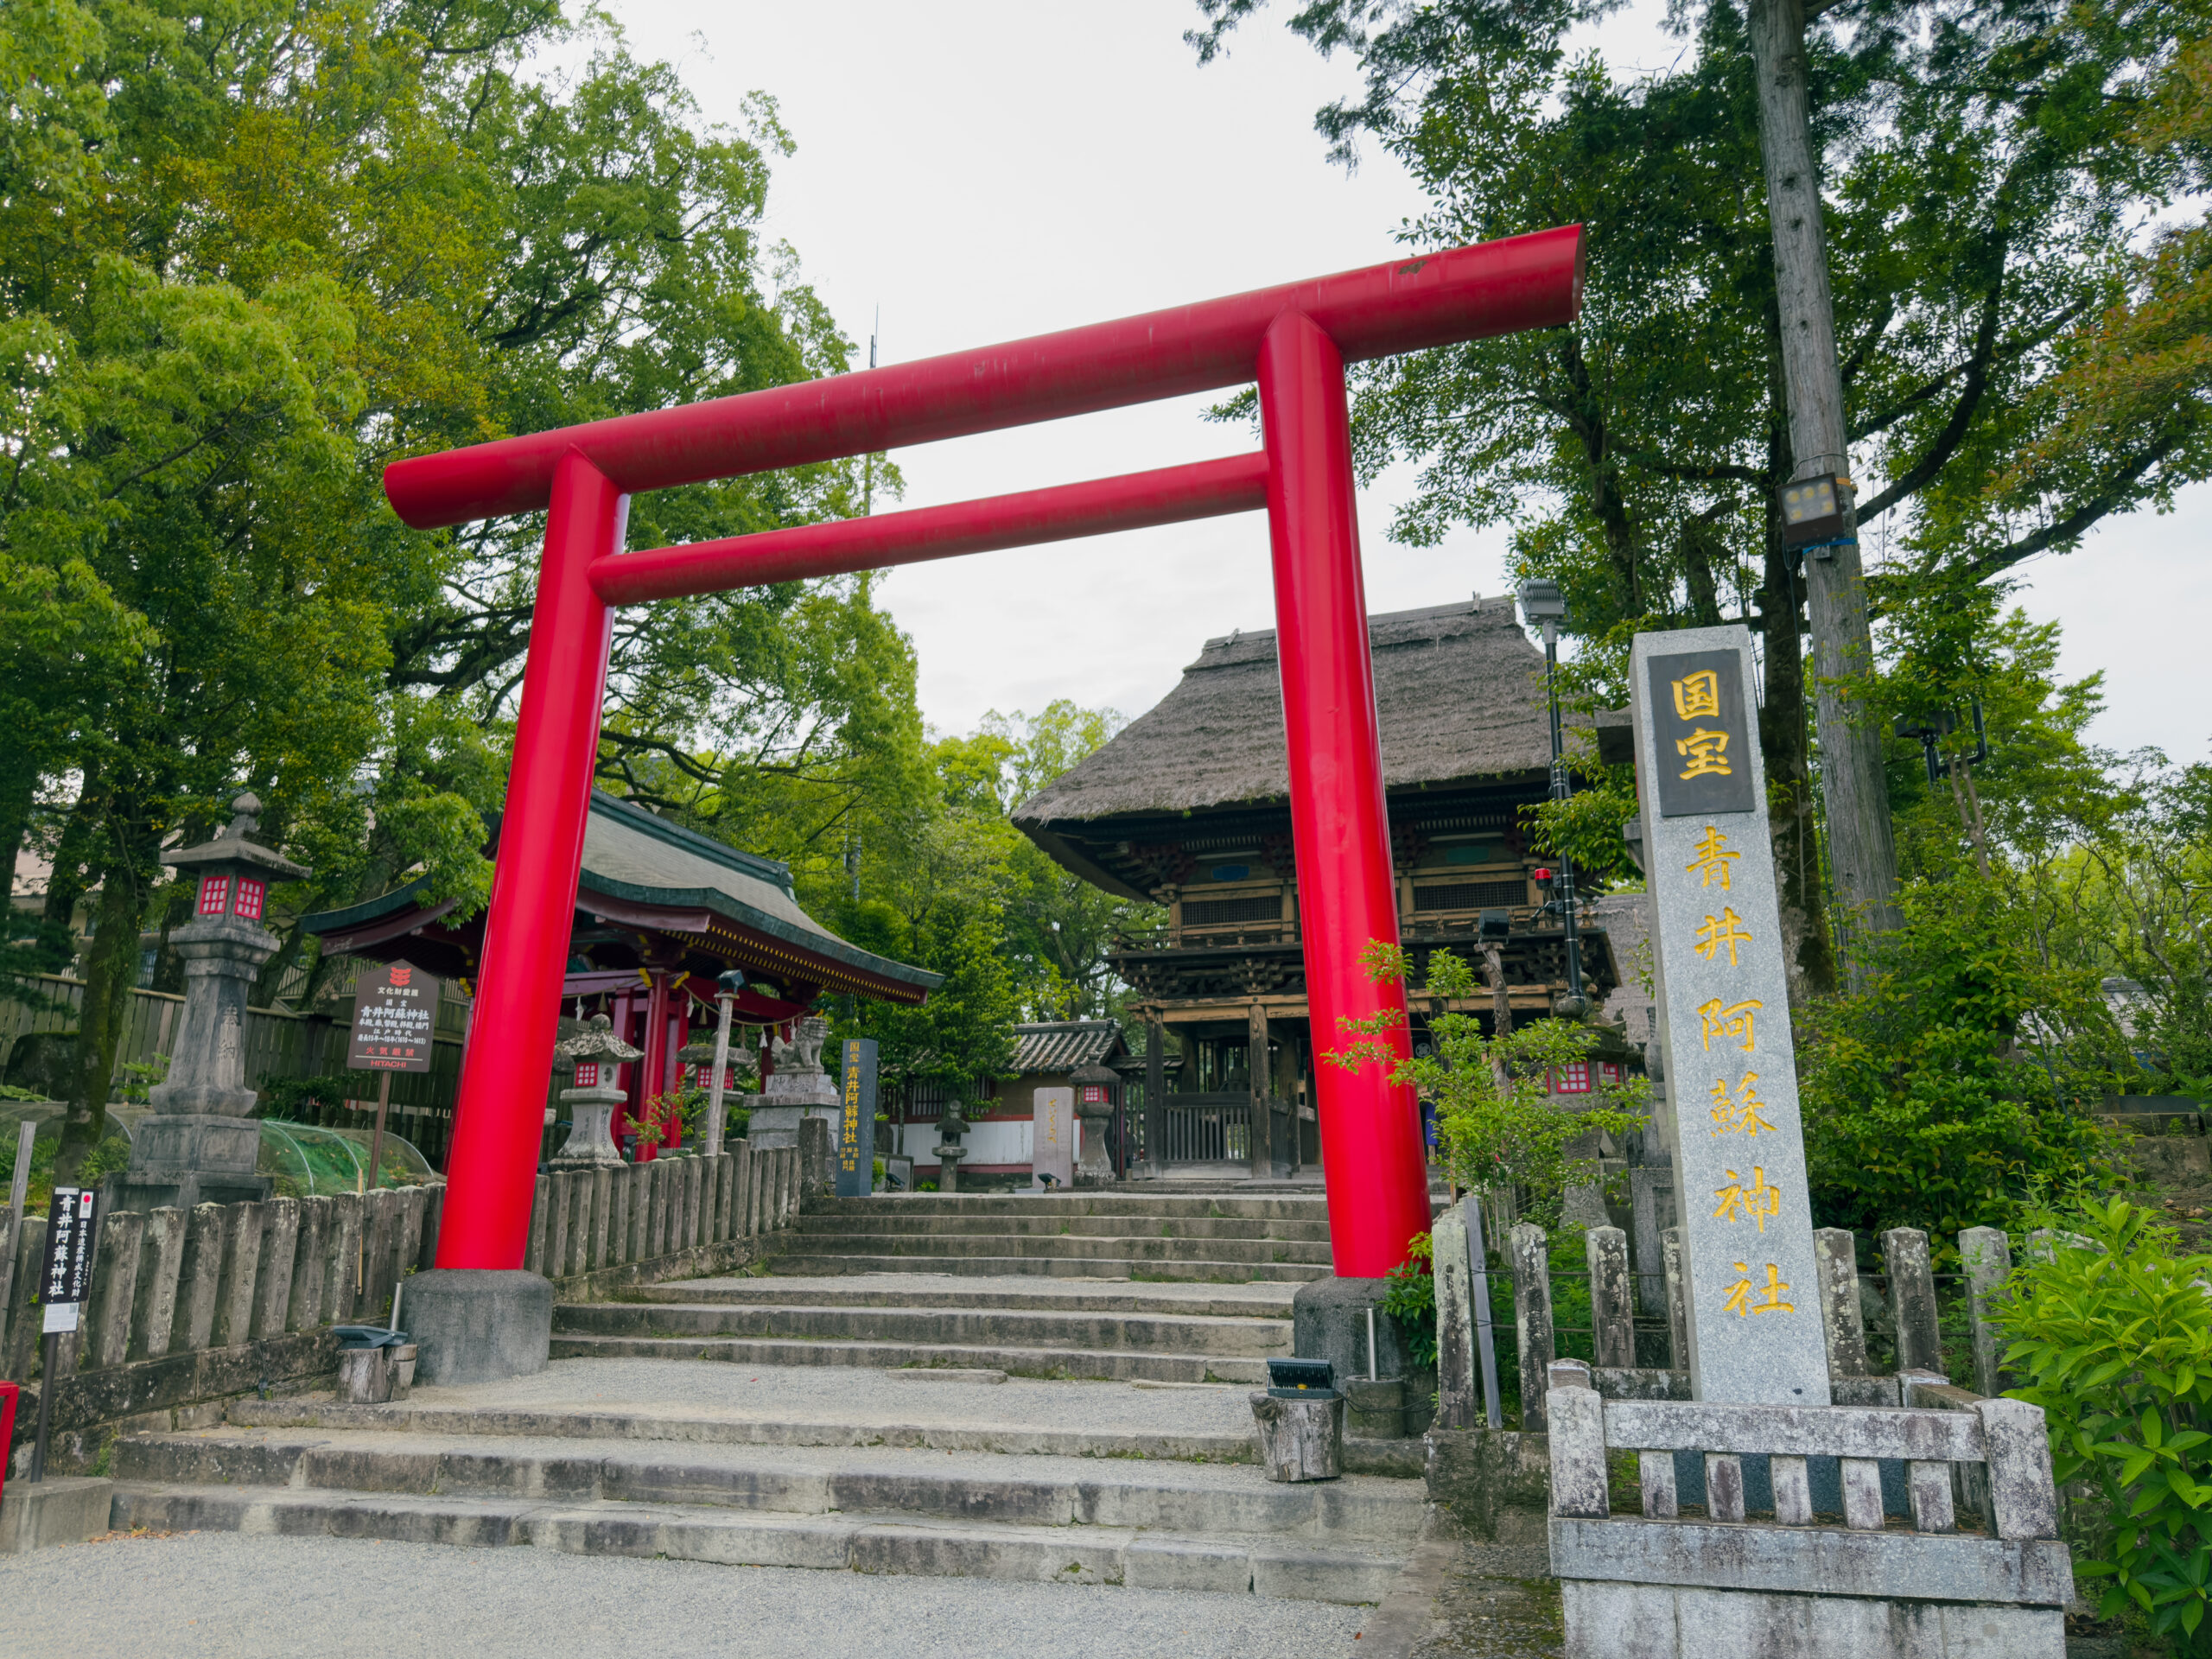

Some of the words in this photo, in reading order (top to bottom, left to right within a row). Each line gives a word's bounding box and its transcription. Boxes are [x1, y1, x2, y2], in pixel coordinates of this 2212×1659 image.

[1671, 669, 1732, 780] 国宝
[361, 1005, 429, 1020] 青井阿蘇神社
[371, 1059, 407, 1068] HITACHI
[1686, 825, 1795, 1317] 青井阿蘇神社
[842, 1066, 861, 1144] 青井阿蘇神社
[48, 1195, 76, 1298] 青井阿蘇神社
[72, 1221, 88, 1298] 日本遺産構成文化財
